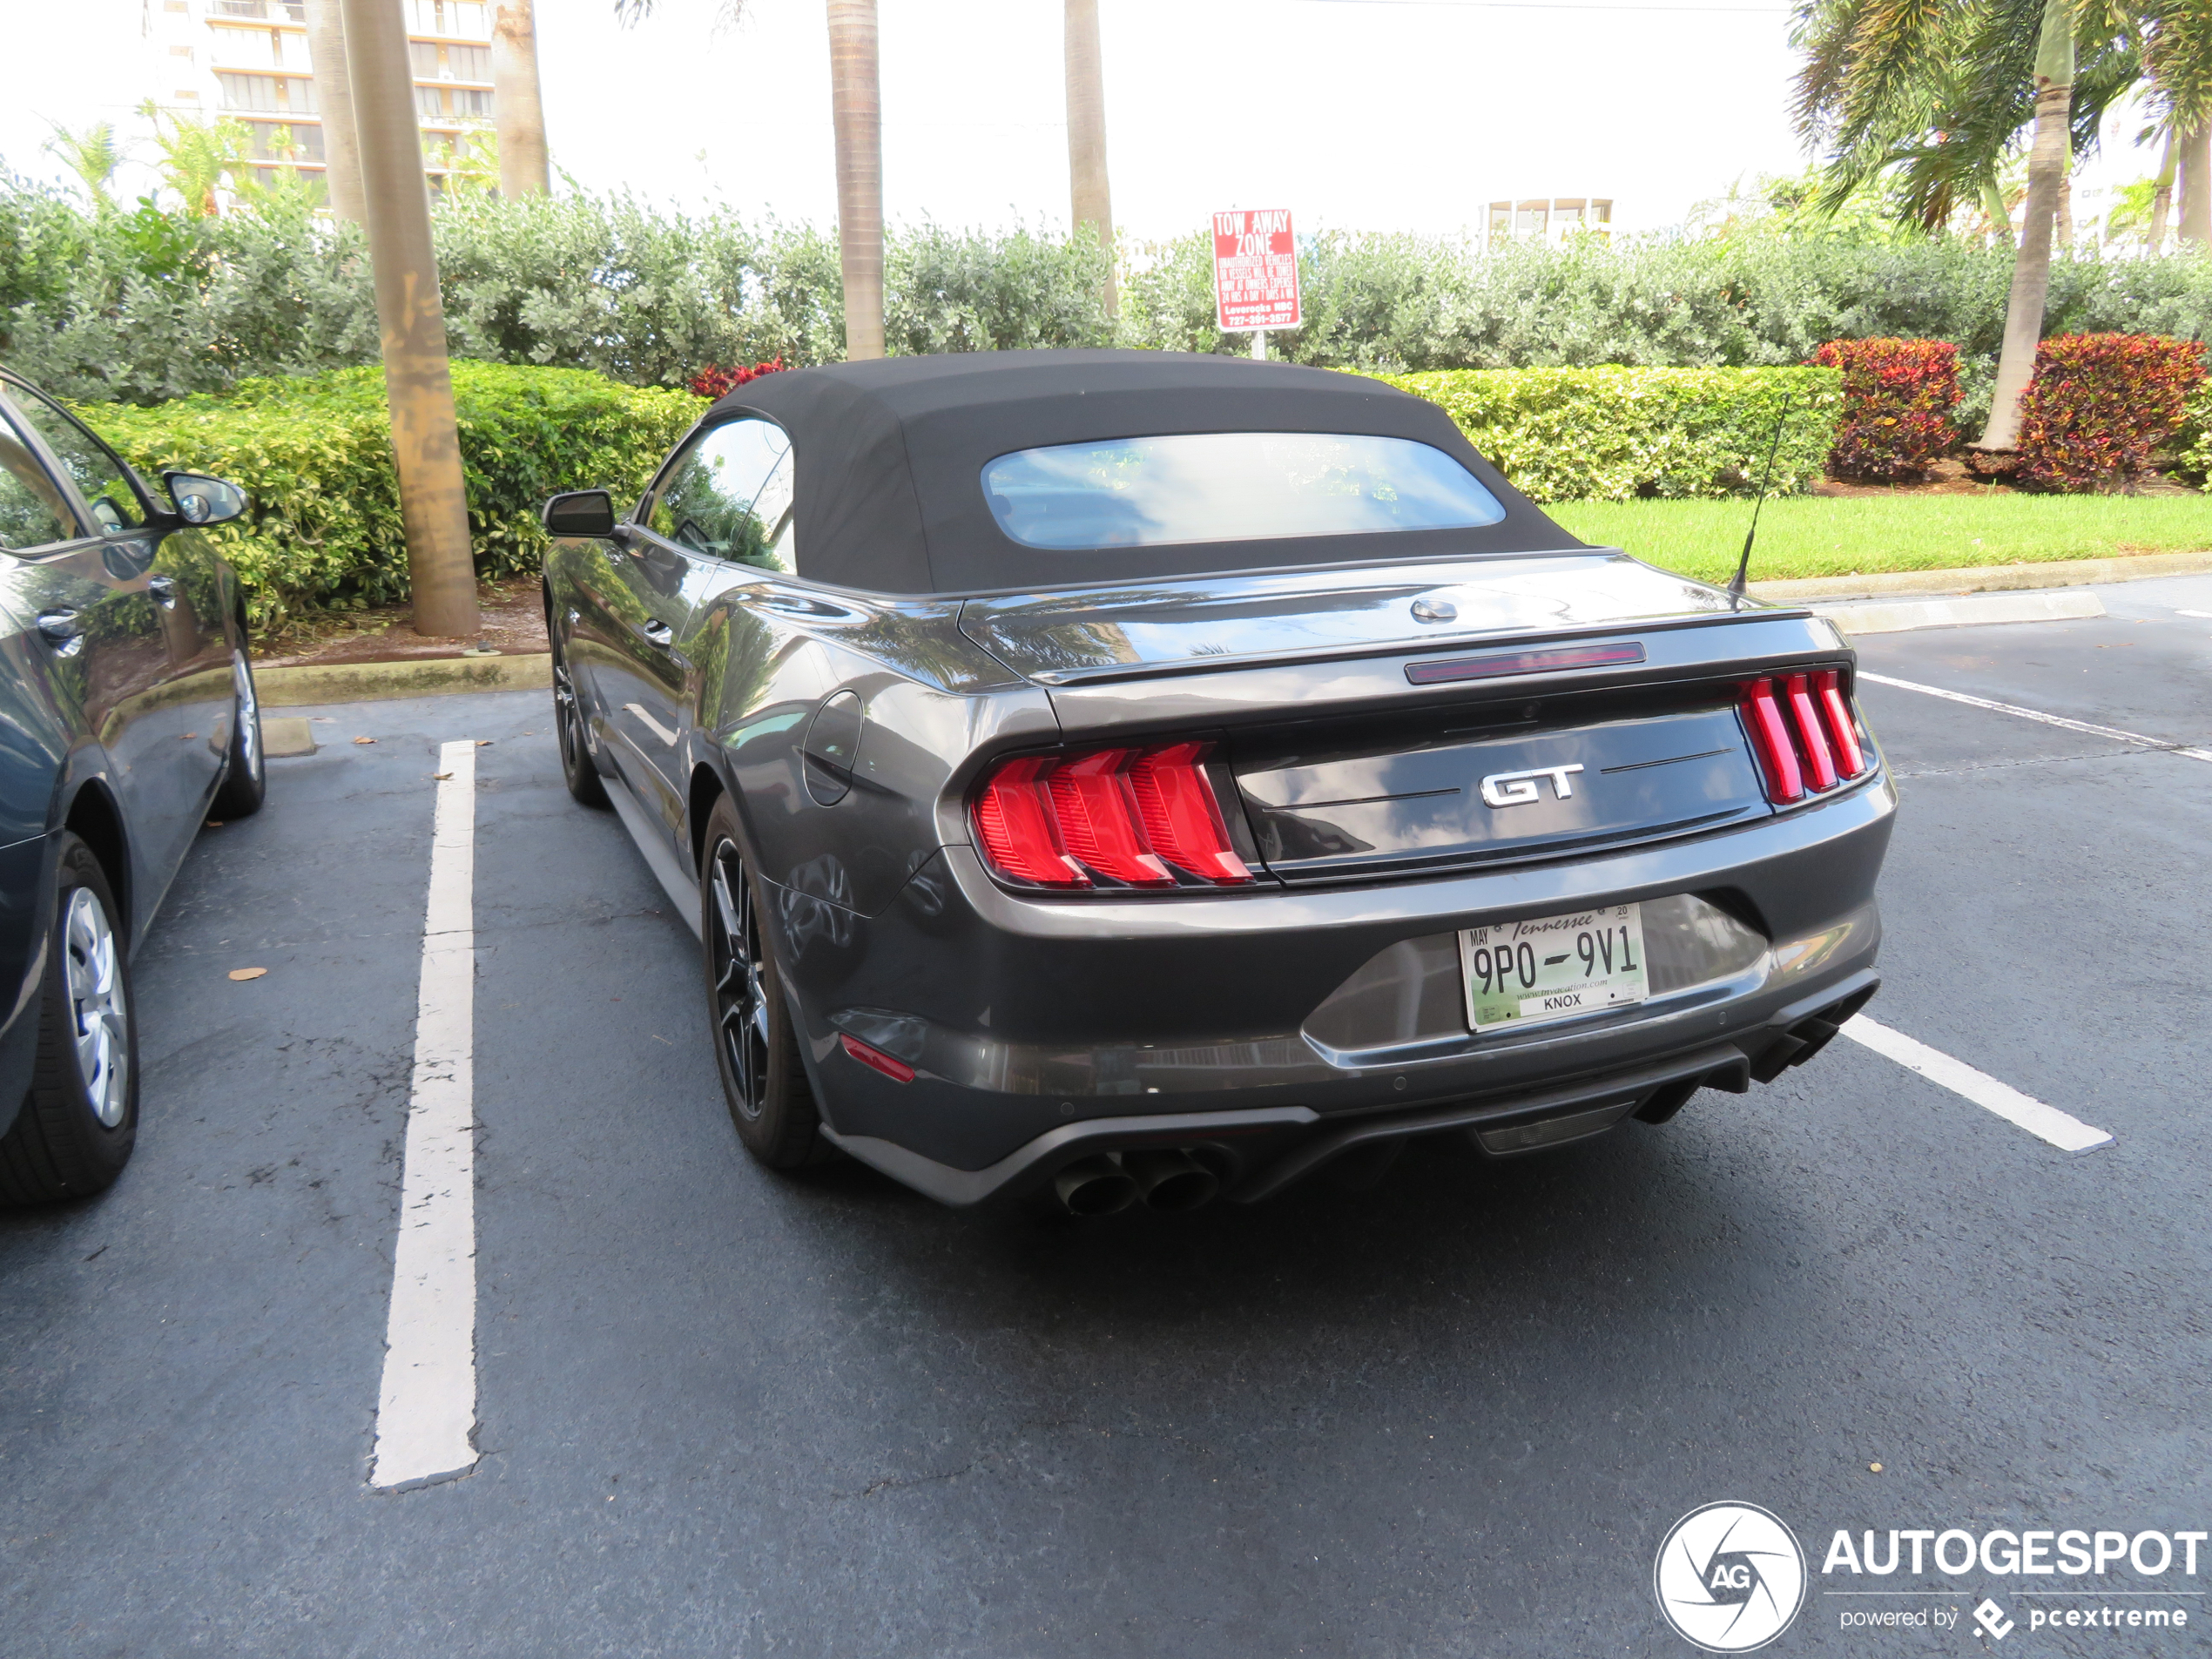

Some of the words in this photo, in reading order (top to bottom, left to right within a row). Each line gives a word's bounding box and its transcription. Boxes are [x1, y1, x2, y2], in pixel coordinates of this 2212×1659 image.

[1215, 212, 1245, 236] TOW
[1252, 211, 1288, 234] AWAY
[1235, 233, 1274, 256] ZONE
[1218, 256, 1263, 268] UNAUTHORIZED
[1264, 253, 1292, 266] VEHICLES
[1220, 268, 1227, 280] OR
[1229, 267, 1252, 280] VESSELS
[1253, 266, 1266, 278] WILL
[1267, 266, 1274, 278] BE
[1276, 265, 1293, 277] TOWED
[1221, 280, 1235, 292] AWAY
[1238, 279, 1244, 291] AT
[1270, 276, 1294, 288] EXPENSE
[1222, 292, 1230, 303] 24
[1231, 291, 1243, 302] HRS
[1244, 290, 1249, 301] A
[1250, 289, 1259, 301] DAY
[1266, 288, 1279, 300] DAYS
[1224, 303, 1271, 314] Leverocks
[1229, 314, 1291, 326] 727-391-3577
[1479, 764, 1584, 809] GT
[1617, 906, 1628, 915] 20
[1511, 914, 1594, 941] Tennessee
[1470, 928, 1488, 948] MAY
[1544, 994, 1581, 1010] KNOX
